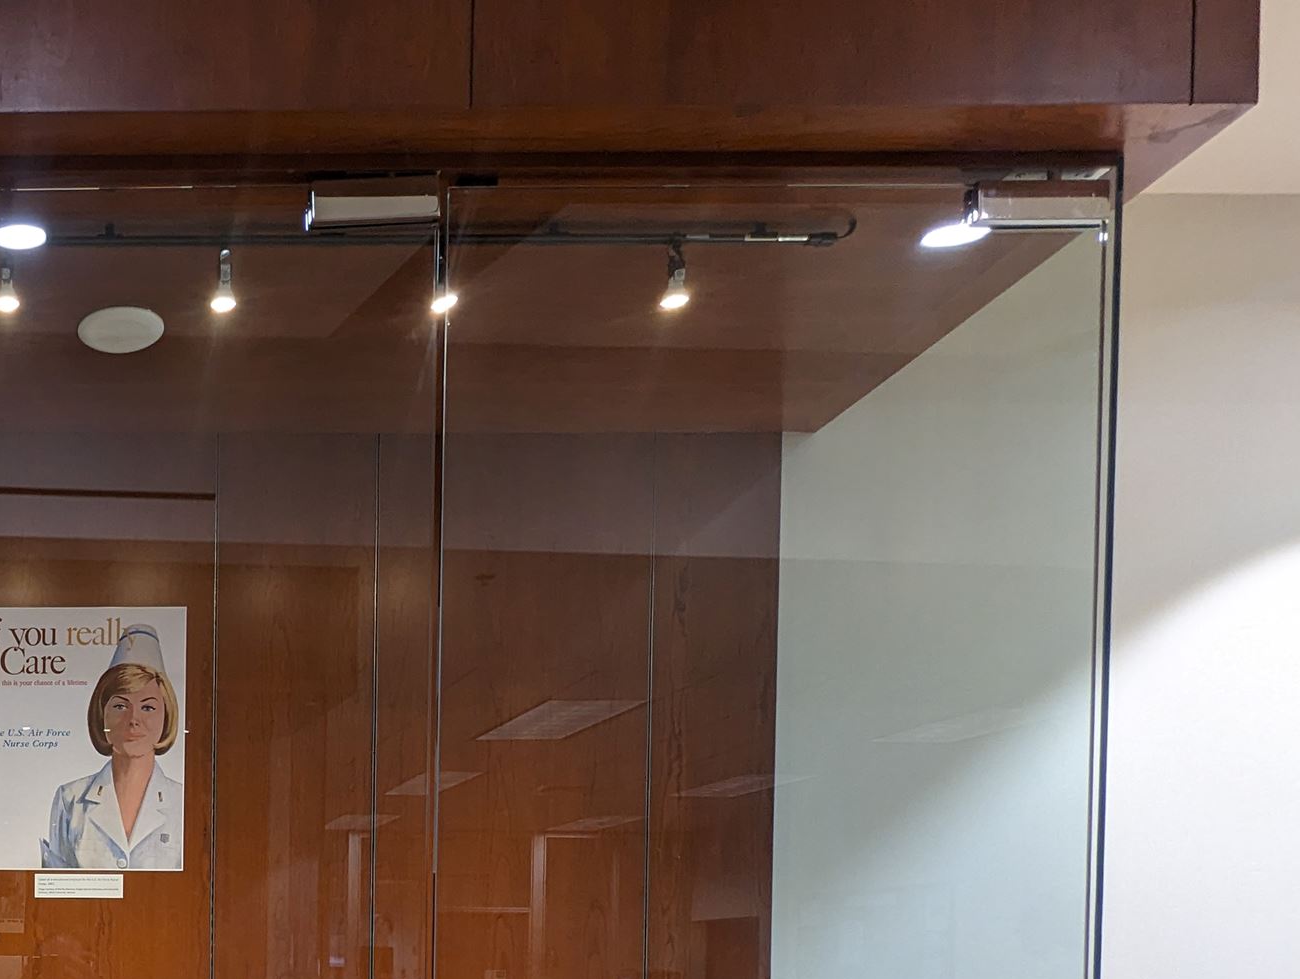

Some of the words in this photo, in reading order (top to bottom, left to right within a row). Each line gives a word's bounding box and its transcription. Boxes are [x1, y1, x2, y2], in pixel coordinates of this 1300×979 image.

[9, 627, 57, 648] you
[67, 618, 136, 649] really
[0, 647, 66, 675] Care
[32, 740, 58, 749] Corps
